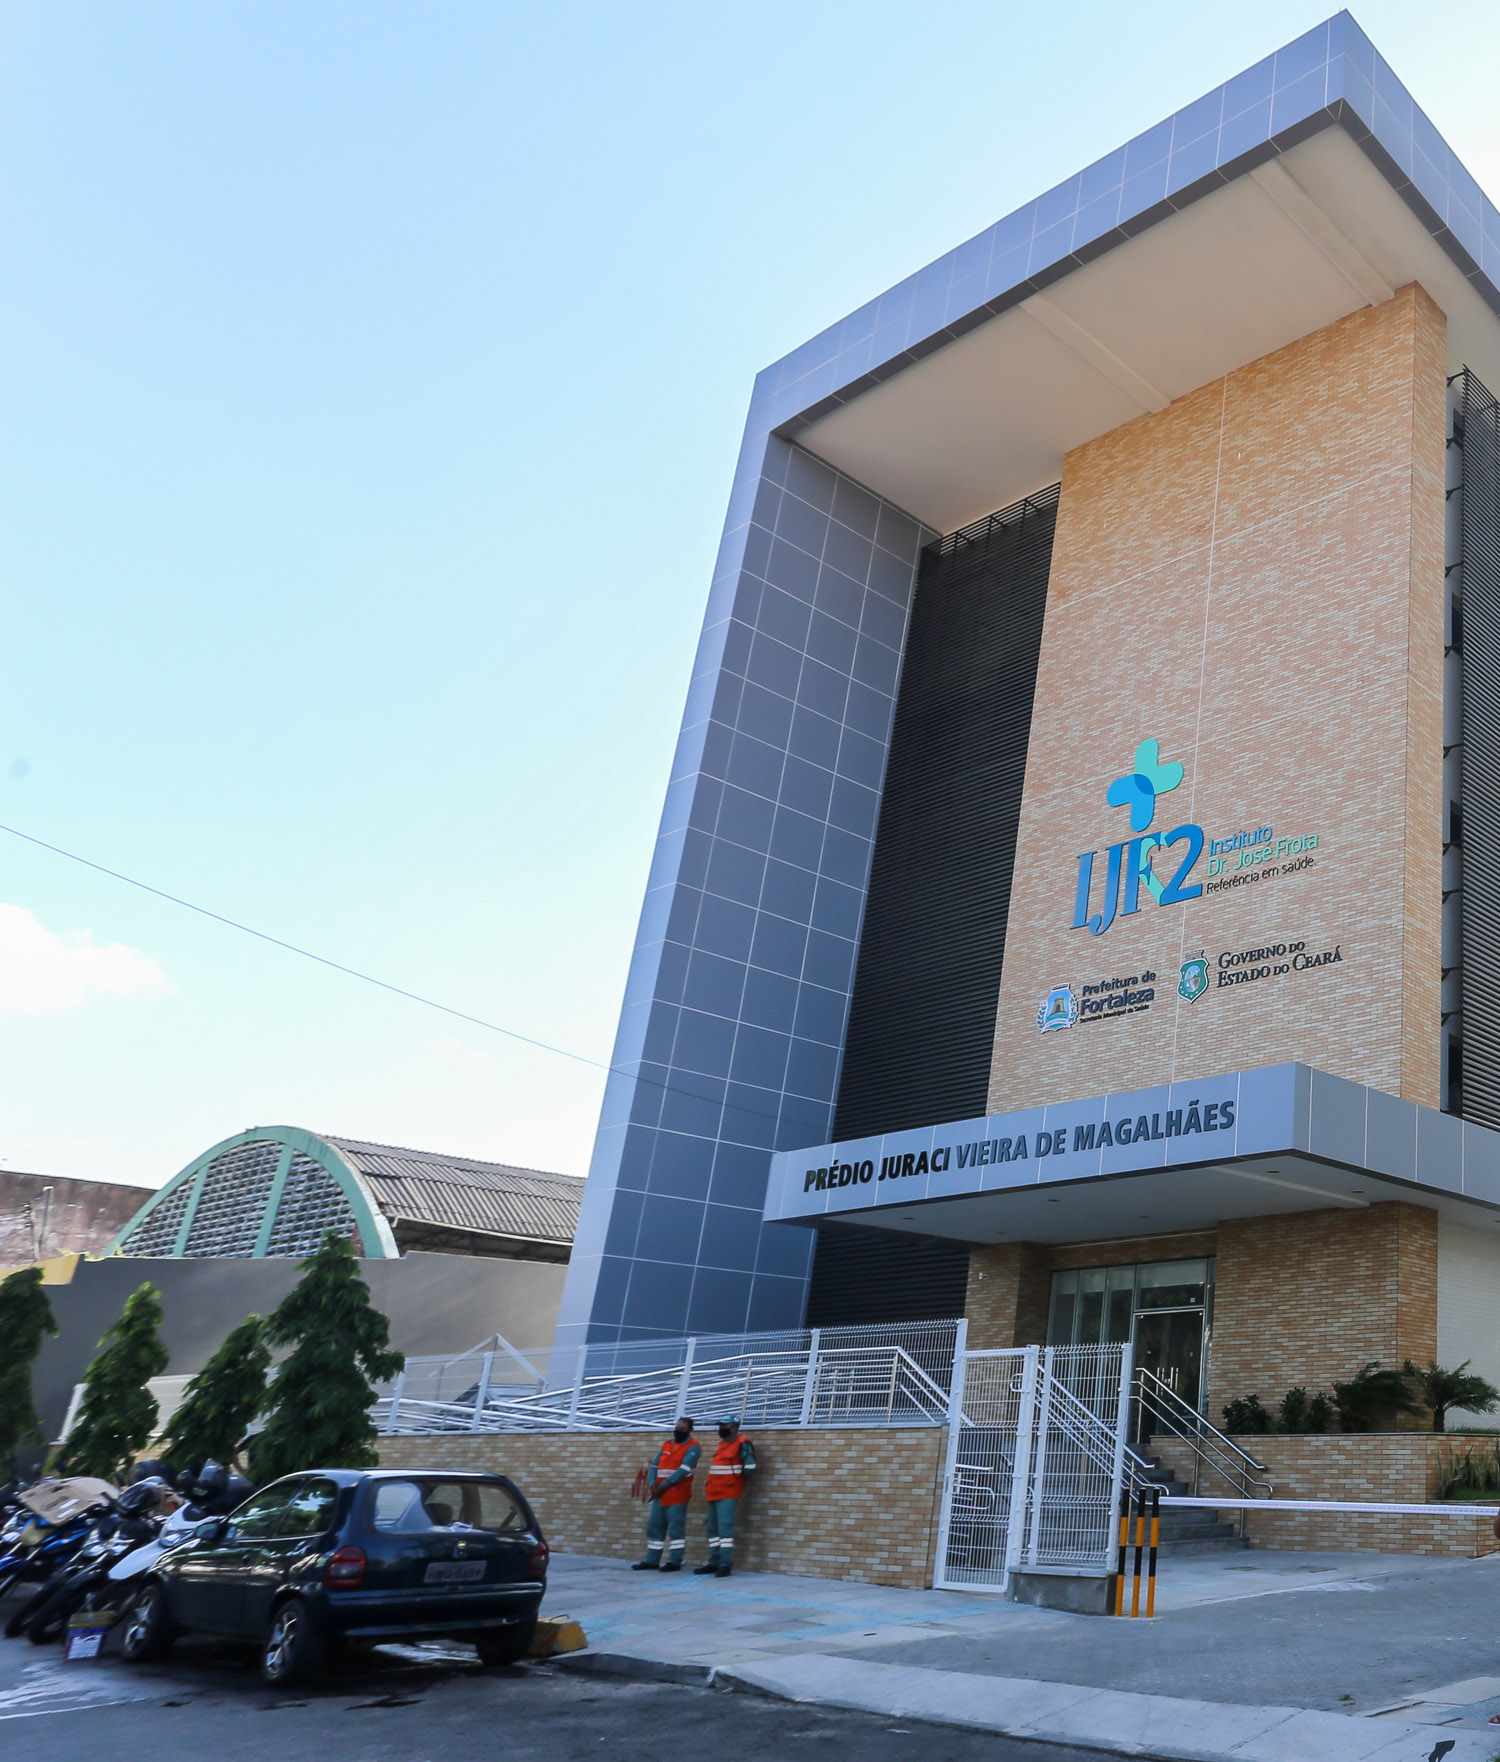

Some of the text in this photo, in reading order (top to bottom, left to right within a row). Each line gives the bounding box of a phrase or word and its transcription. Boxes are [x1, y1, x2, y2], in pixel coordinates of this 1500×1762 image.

[1207, 834, 1319, 877] Dr. José Frota
[1208, 826, 1273, 857] Instituto
[1206, 856, 1317, 894] Referência em saúde.
[1292, 944, 1343, 971] CEARÁ
[1082, 970, 1157, 996] Prefeitura de
[1080, 987, 1155, 1015] Fortaleza
[803, 1099, 1235, 1193] PRÉDIO JURACI VIEIRA DE MAGALHÃES
